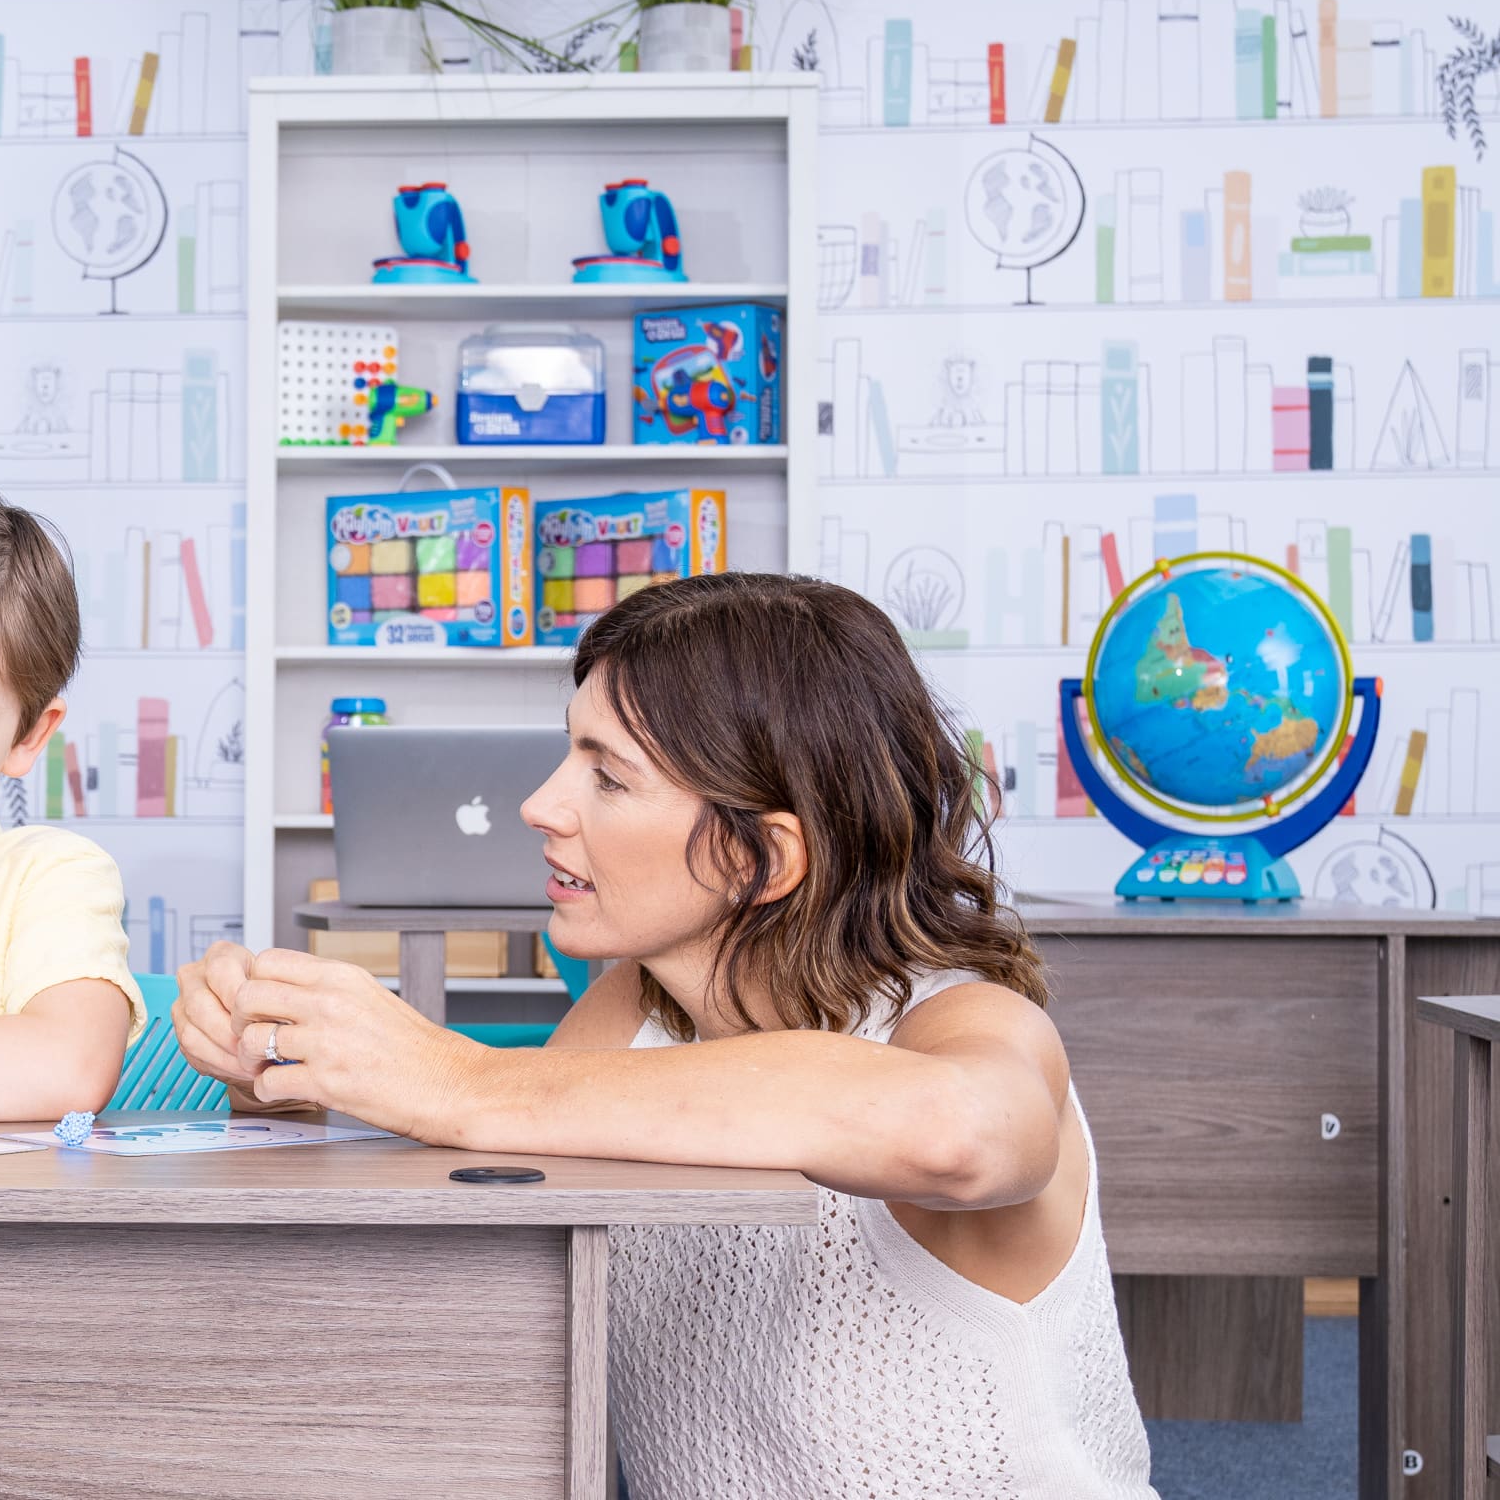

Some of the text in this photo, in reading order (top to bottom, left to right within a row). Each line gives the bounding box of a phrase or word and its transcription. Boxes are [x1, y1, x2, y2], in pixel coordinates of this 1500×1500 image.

[397, 515, 444, 533] VAULT
[598, 517, 640, 536] VAULT
[387, 624, 404, 644] 32
